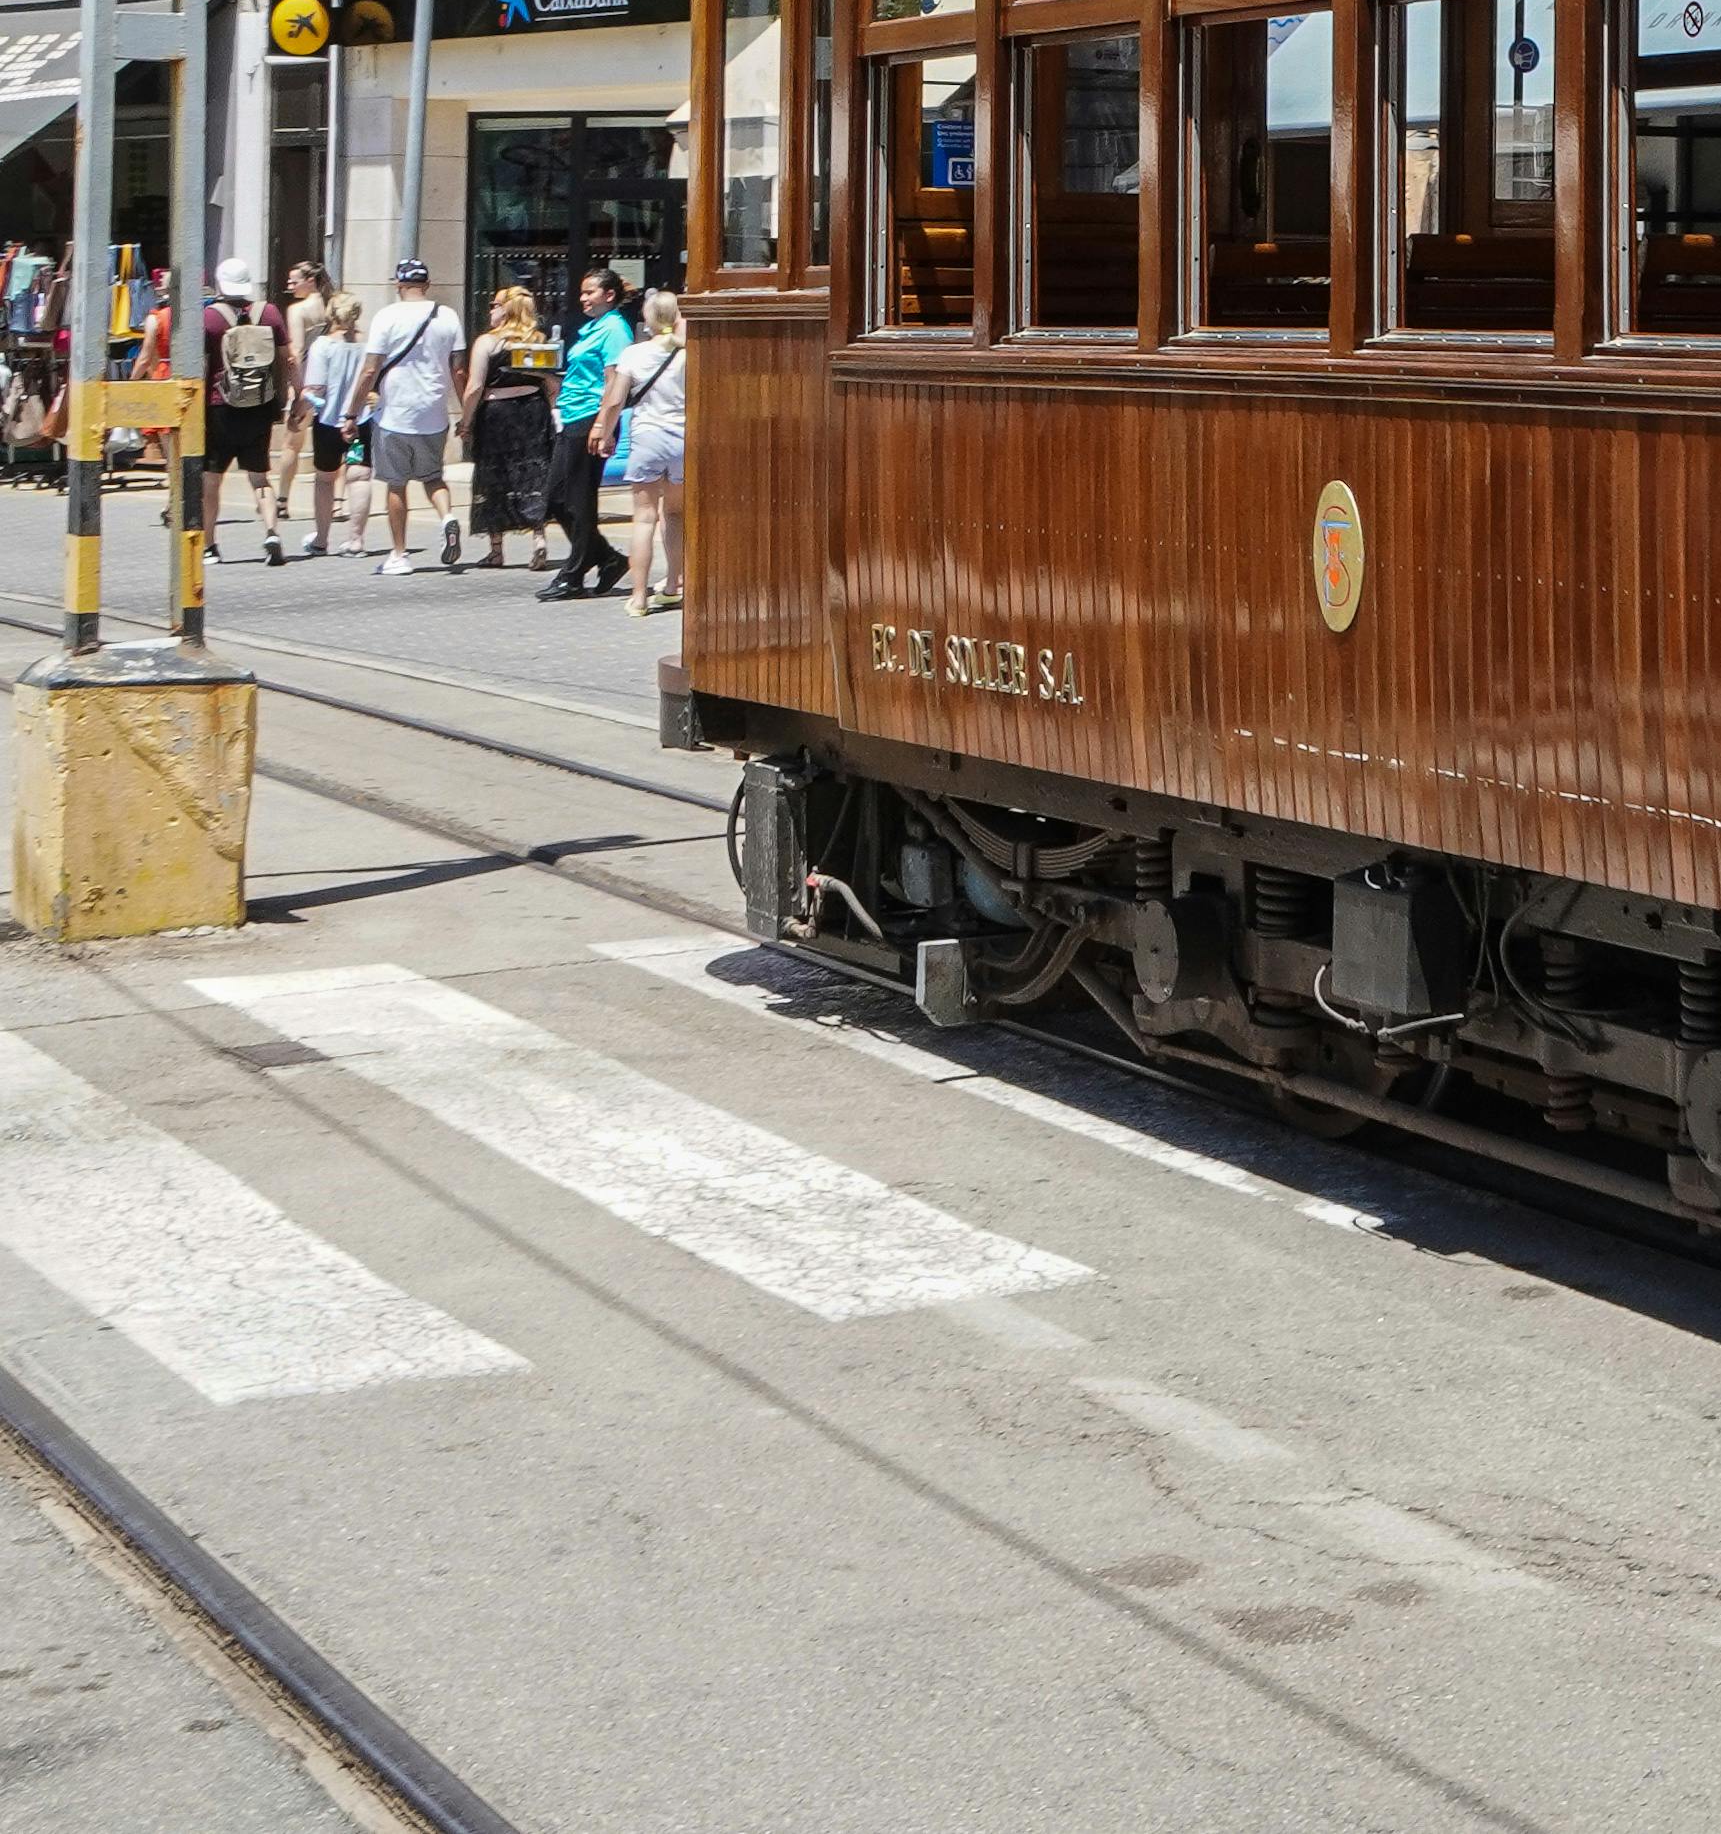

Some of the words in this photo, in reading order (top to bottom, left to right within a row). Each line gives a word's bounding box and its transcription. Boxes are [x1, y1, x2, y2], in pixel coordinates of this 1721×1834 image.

[906, 628, 936, 680] DE
[944, 633, 1029, 696] SOLLER
[1037, 648, 1085, 705] S.A.
